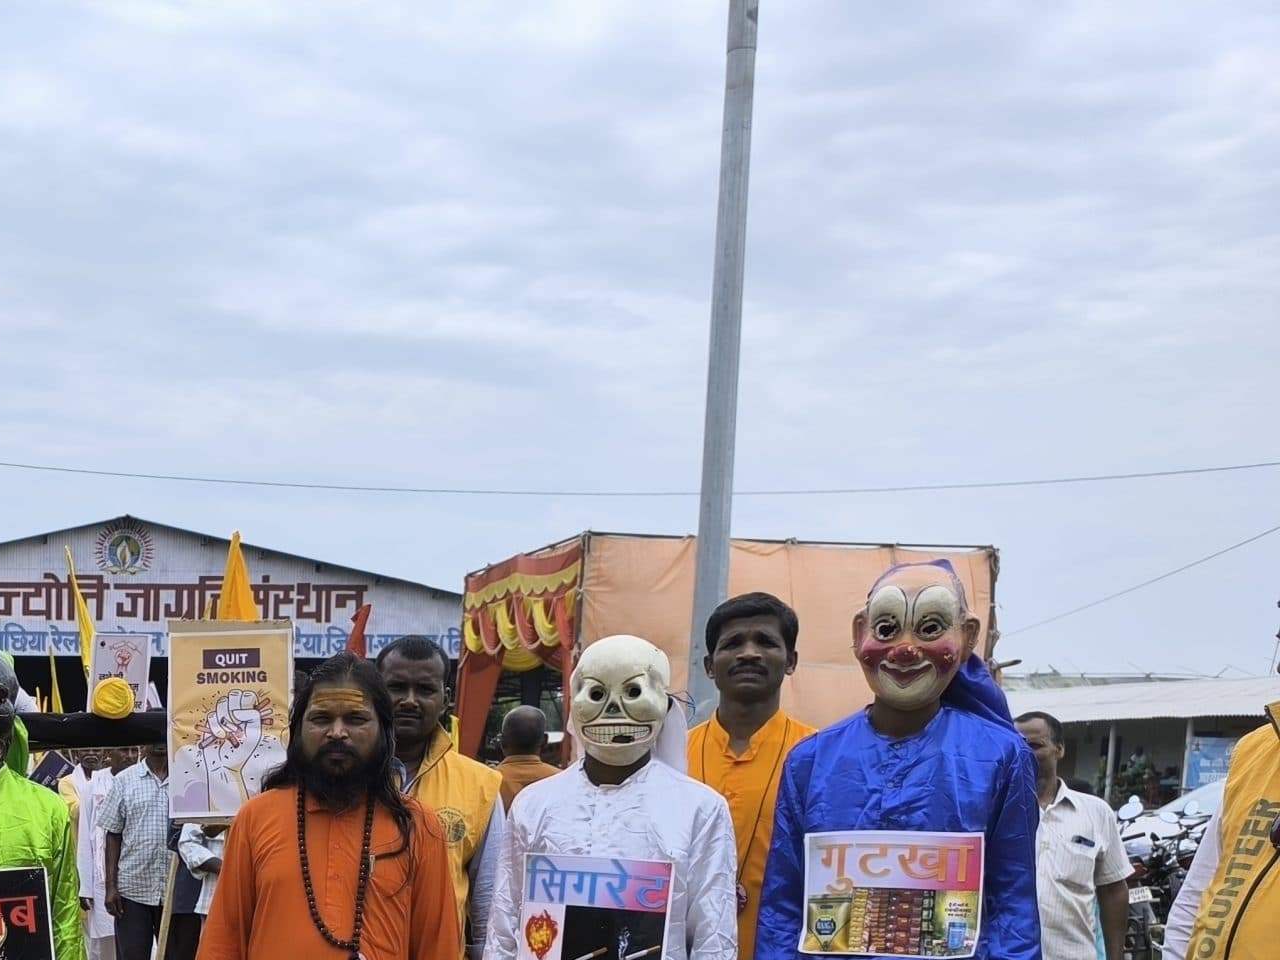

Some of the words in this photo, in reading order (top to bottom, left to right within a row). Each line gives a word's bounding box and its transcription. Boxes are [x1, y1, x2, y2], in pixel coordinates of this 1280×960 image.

[215, 653, 248, 667] QUIT
[196, 670, 267, 685] SMOKING
[527, 855, 671, 909] सिगरेट
[818, 843, 974, 893] गुटखा
